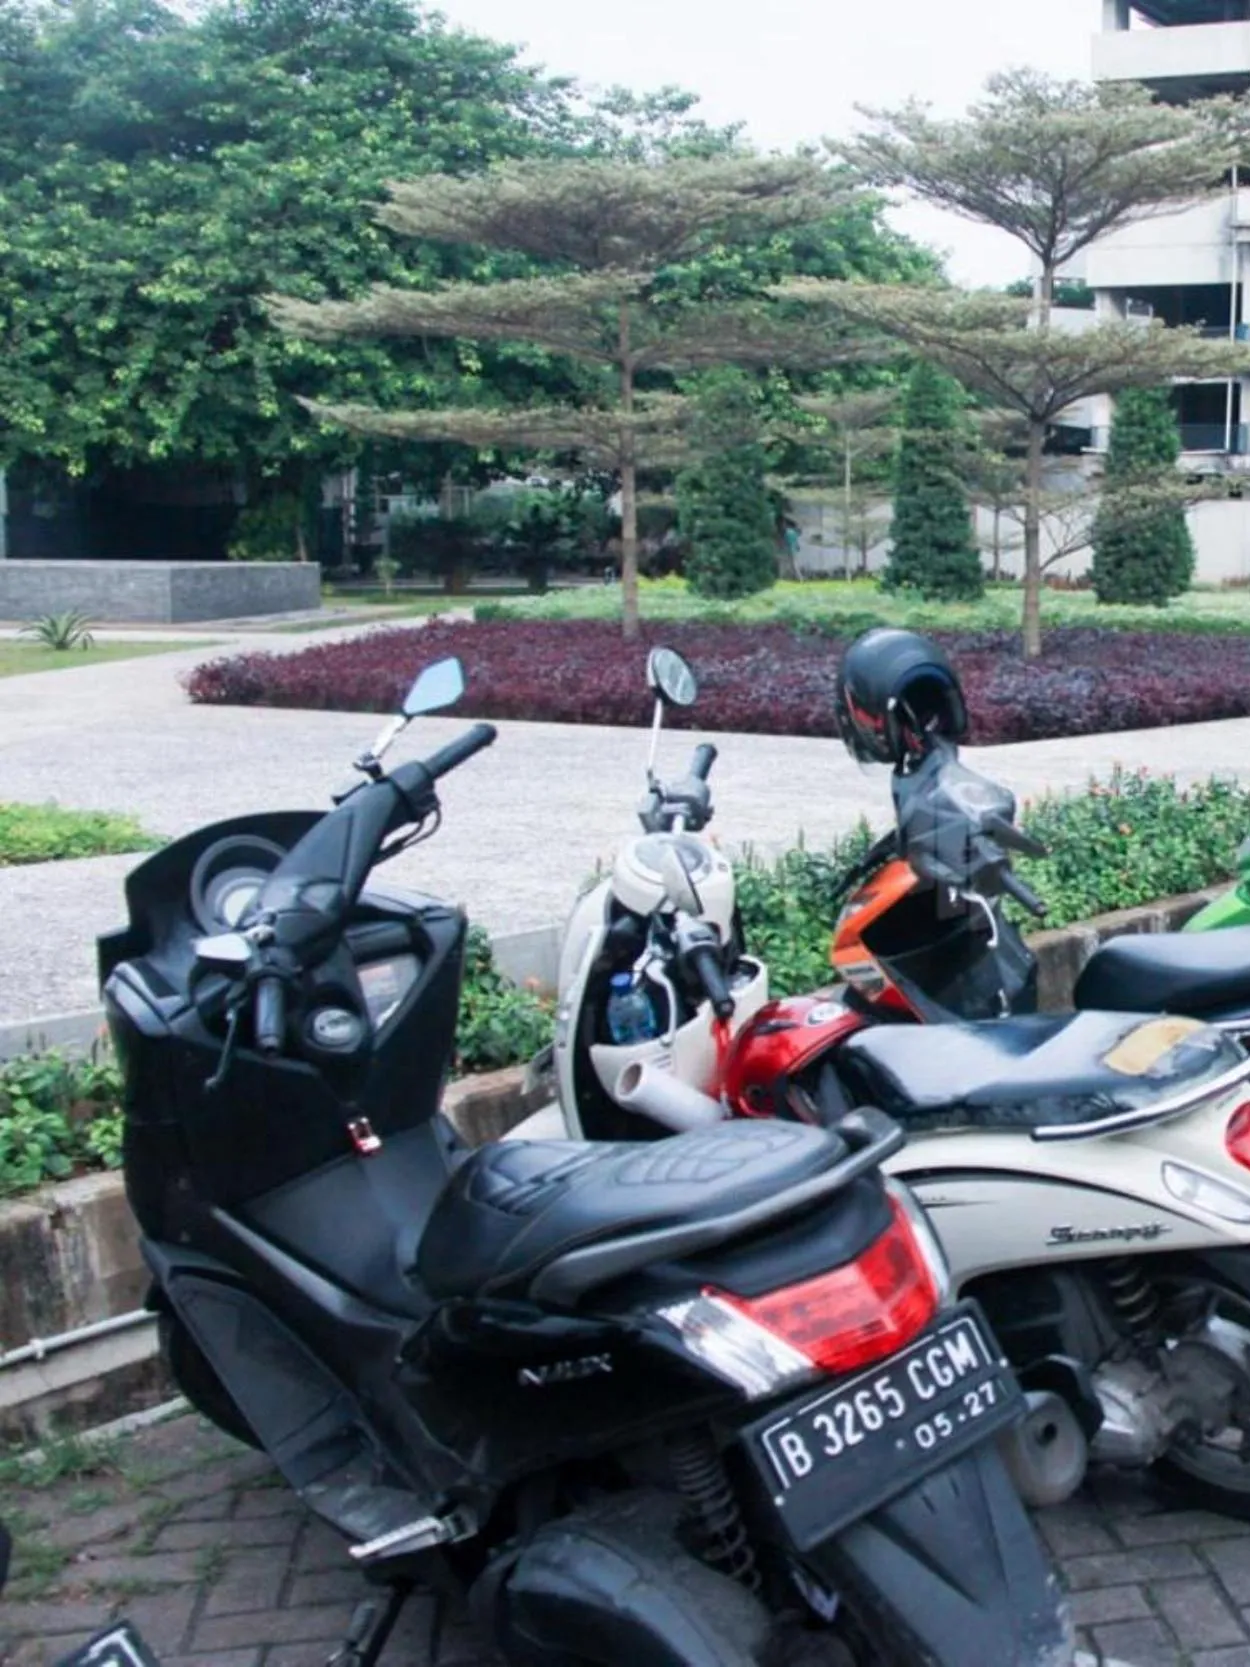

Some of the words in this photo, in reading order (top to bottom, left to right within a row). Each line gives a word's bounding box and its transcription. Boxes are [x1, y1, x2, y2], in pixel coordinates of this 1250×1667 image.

[779, 1431, 814, 1478] B
[814, 1375, 906, 1456] 3265
[907, 1330, 979, 1400] CGM
